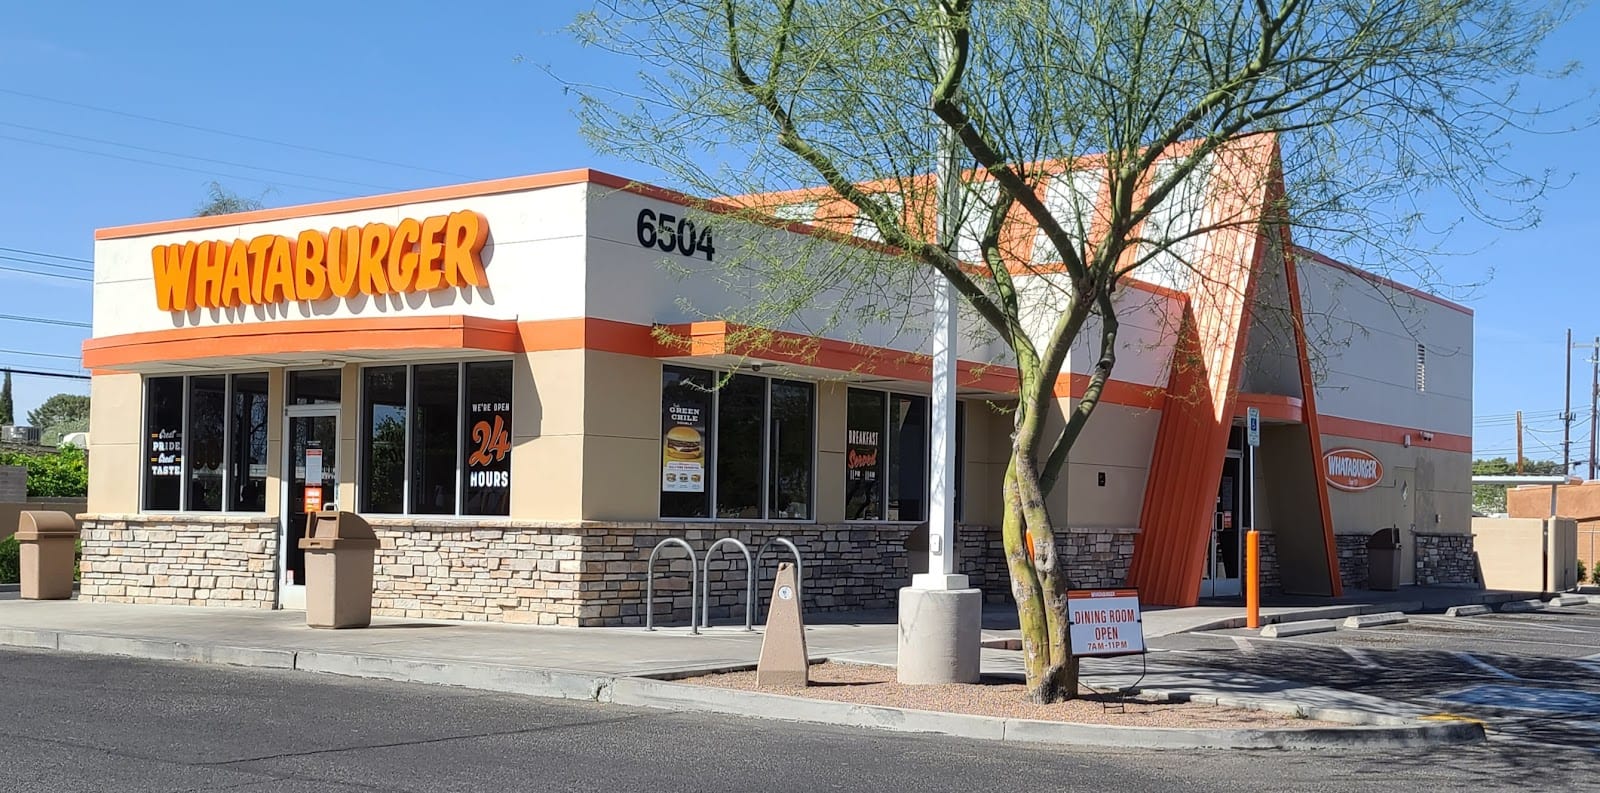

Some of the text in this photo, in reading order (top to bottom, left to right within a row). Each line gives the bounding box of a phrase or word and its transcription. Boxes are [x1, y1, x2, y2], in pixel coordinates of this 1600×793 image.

[637, 209, 715, 261] 6504
[152, 209, 489, 312] WHATABURGER
[494, 403, 510, 411] OPEN
[669, 406, 700, 415] GREEN
[671, 413, 698, 422] CHILE
[468, 415, 512, 467] 24
[848, 430, 878, 446] BREAKFAST
[1328, 455, 1377, 480] WHATABURGER
[470, 471, 508, 487] HOURS
[1075, 609, 1135, 625] DINING ROOM
[1095, 627, 1118, 640] OPEN
